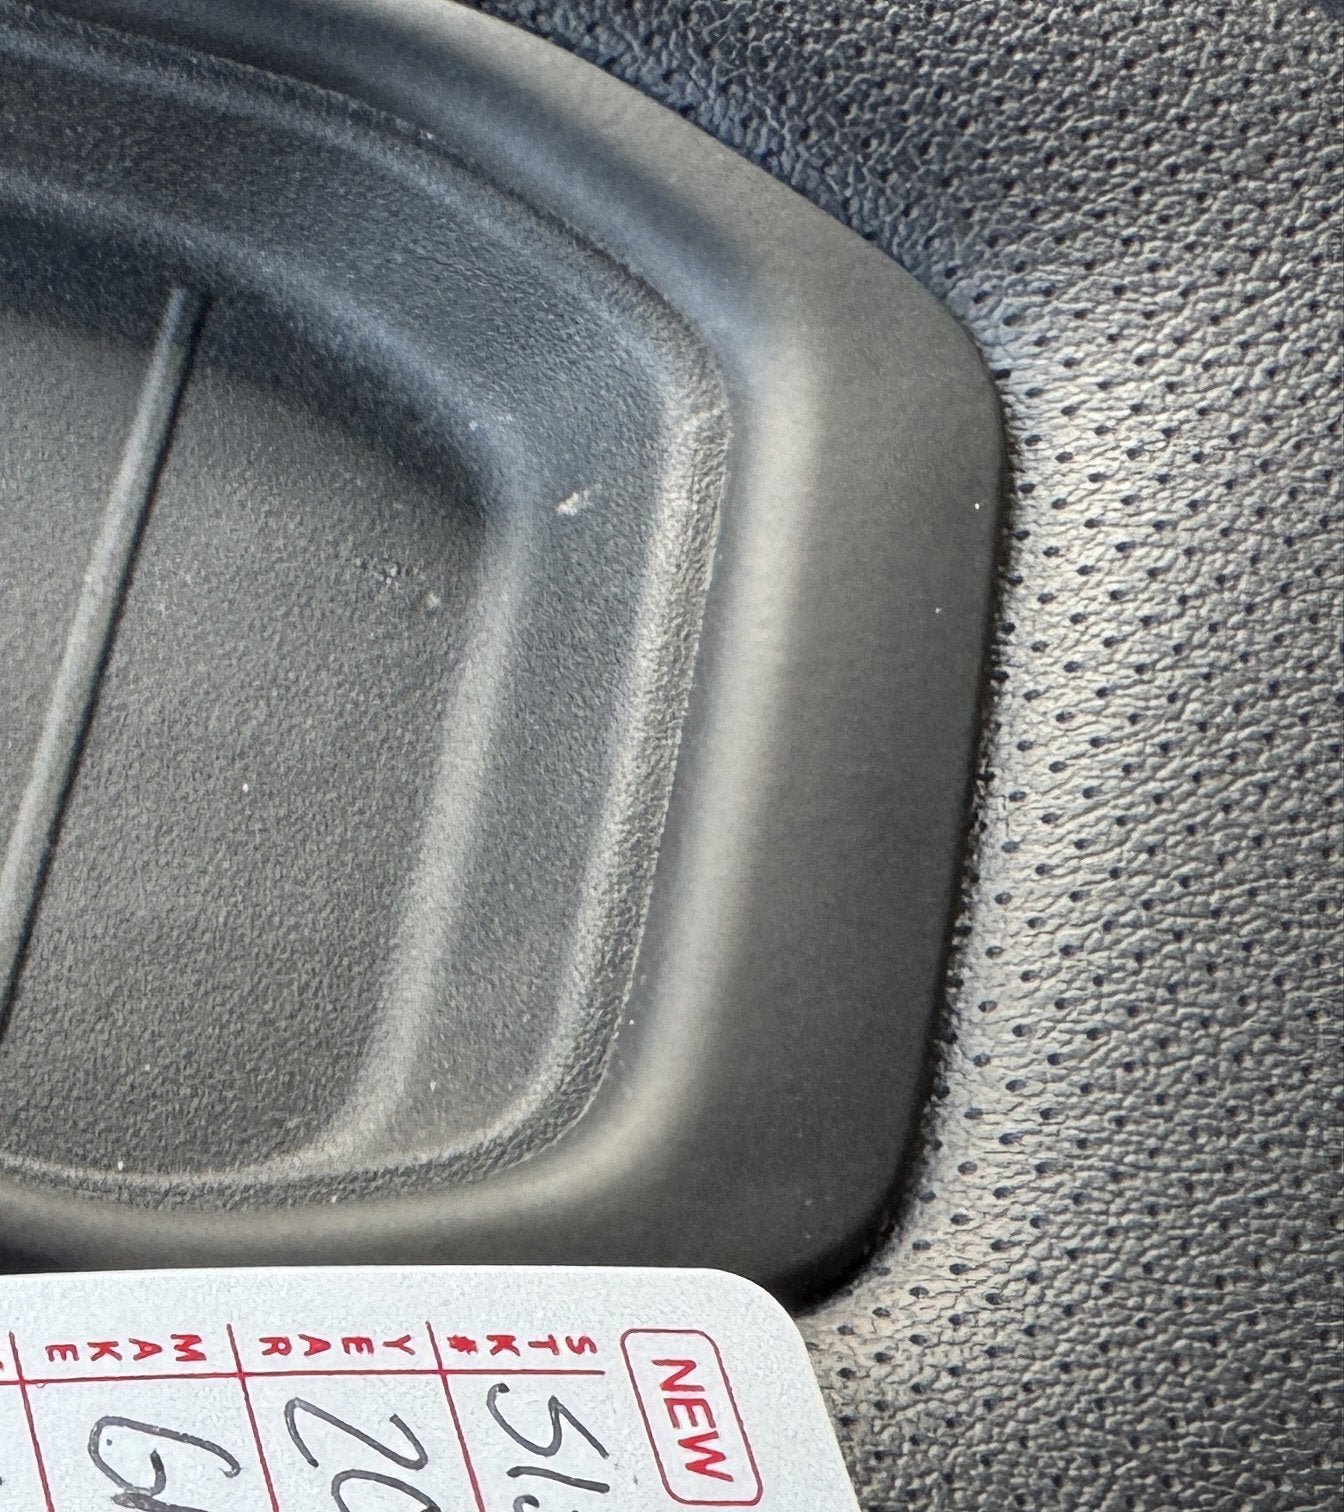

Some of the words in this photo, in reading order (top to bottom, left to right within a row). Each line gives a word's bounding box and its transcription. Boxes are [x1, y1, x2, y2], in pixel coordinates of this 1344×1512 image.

[47, 1333, 207, 1363] MAKE
[259, 1334, 416, 1357] YEAR
[651, 1358, 734, 1483] NEW
